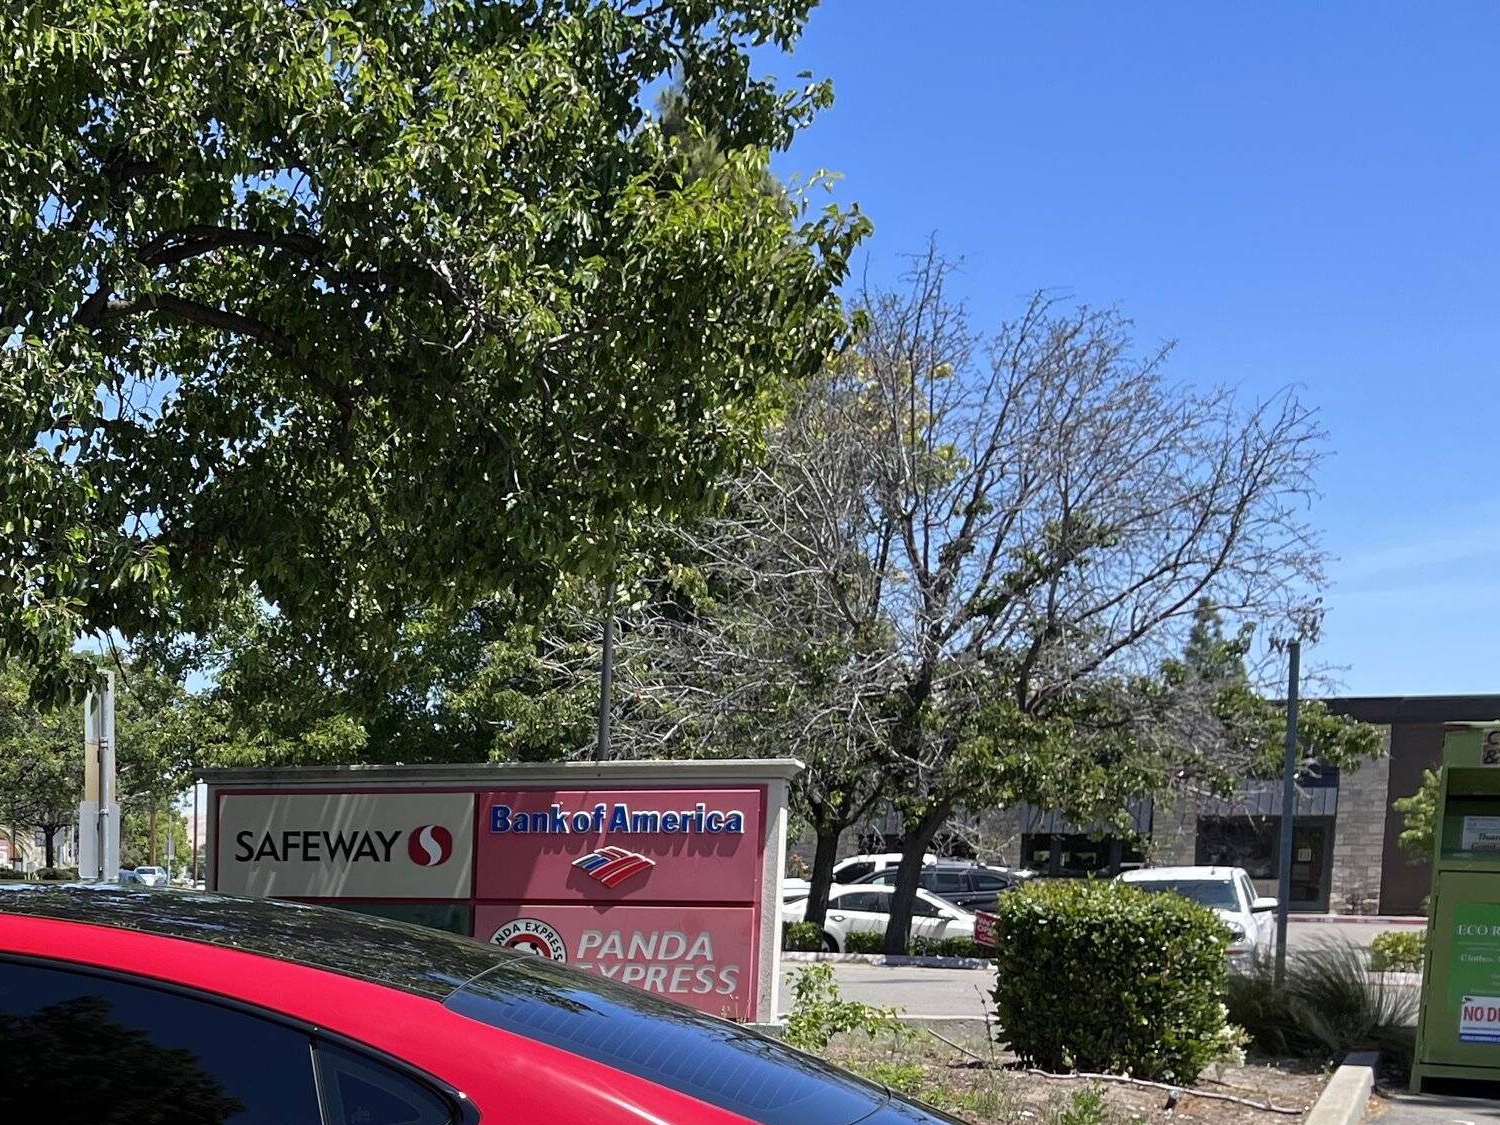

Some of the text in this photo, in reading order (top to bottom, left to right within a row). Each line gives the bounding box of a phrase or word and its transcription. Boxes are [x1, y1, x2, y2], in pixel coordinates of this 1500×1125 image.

[490, 803, 745, 833] Bank of America
[235, 830, 402, 863] SAFEWAY
[494, 922, 563, 960] NDA EXPRESS
[576, 929, 715, 961] PANDA
[1459, 924, 1488, 936] ECO
[575, 962, 741, 994] XPRESS
[1463, 1006, 1484, 1021] NO
